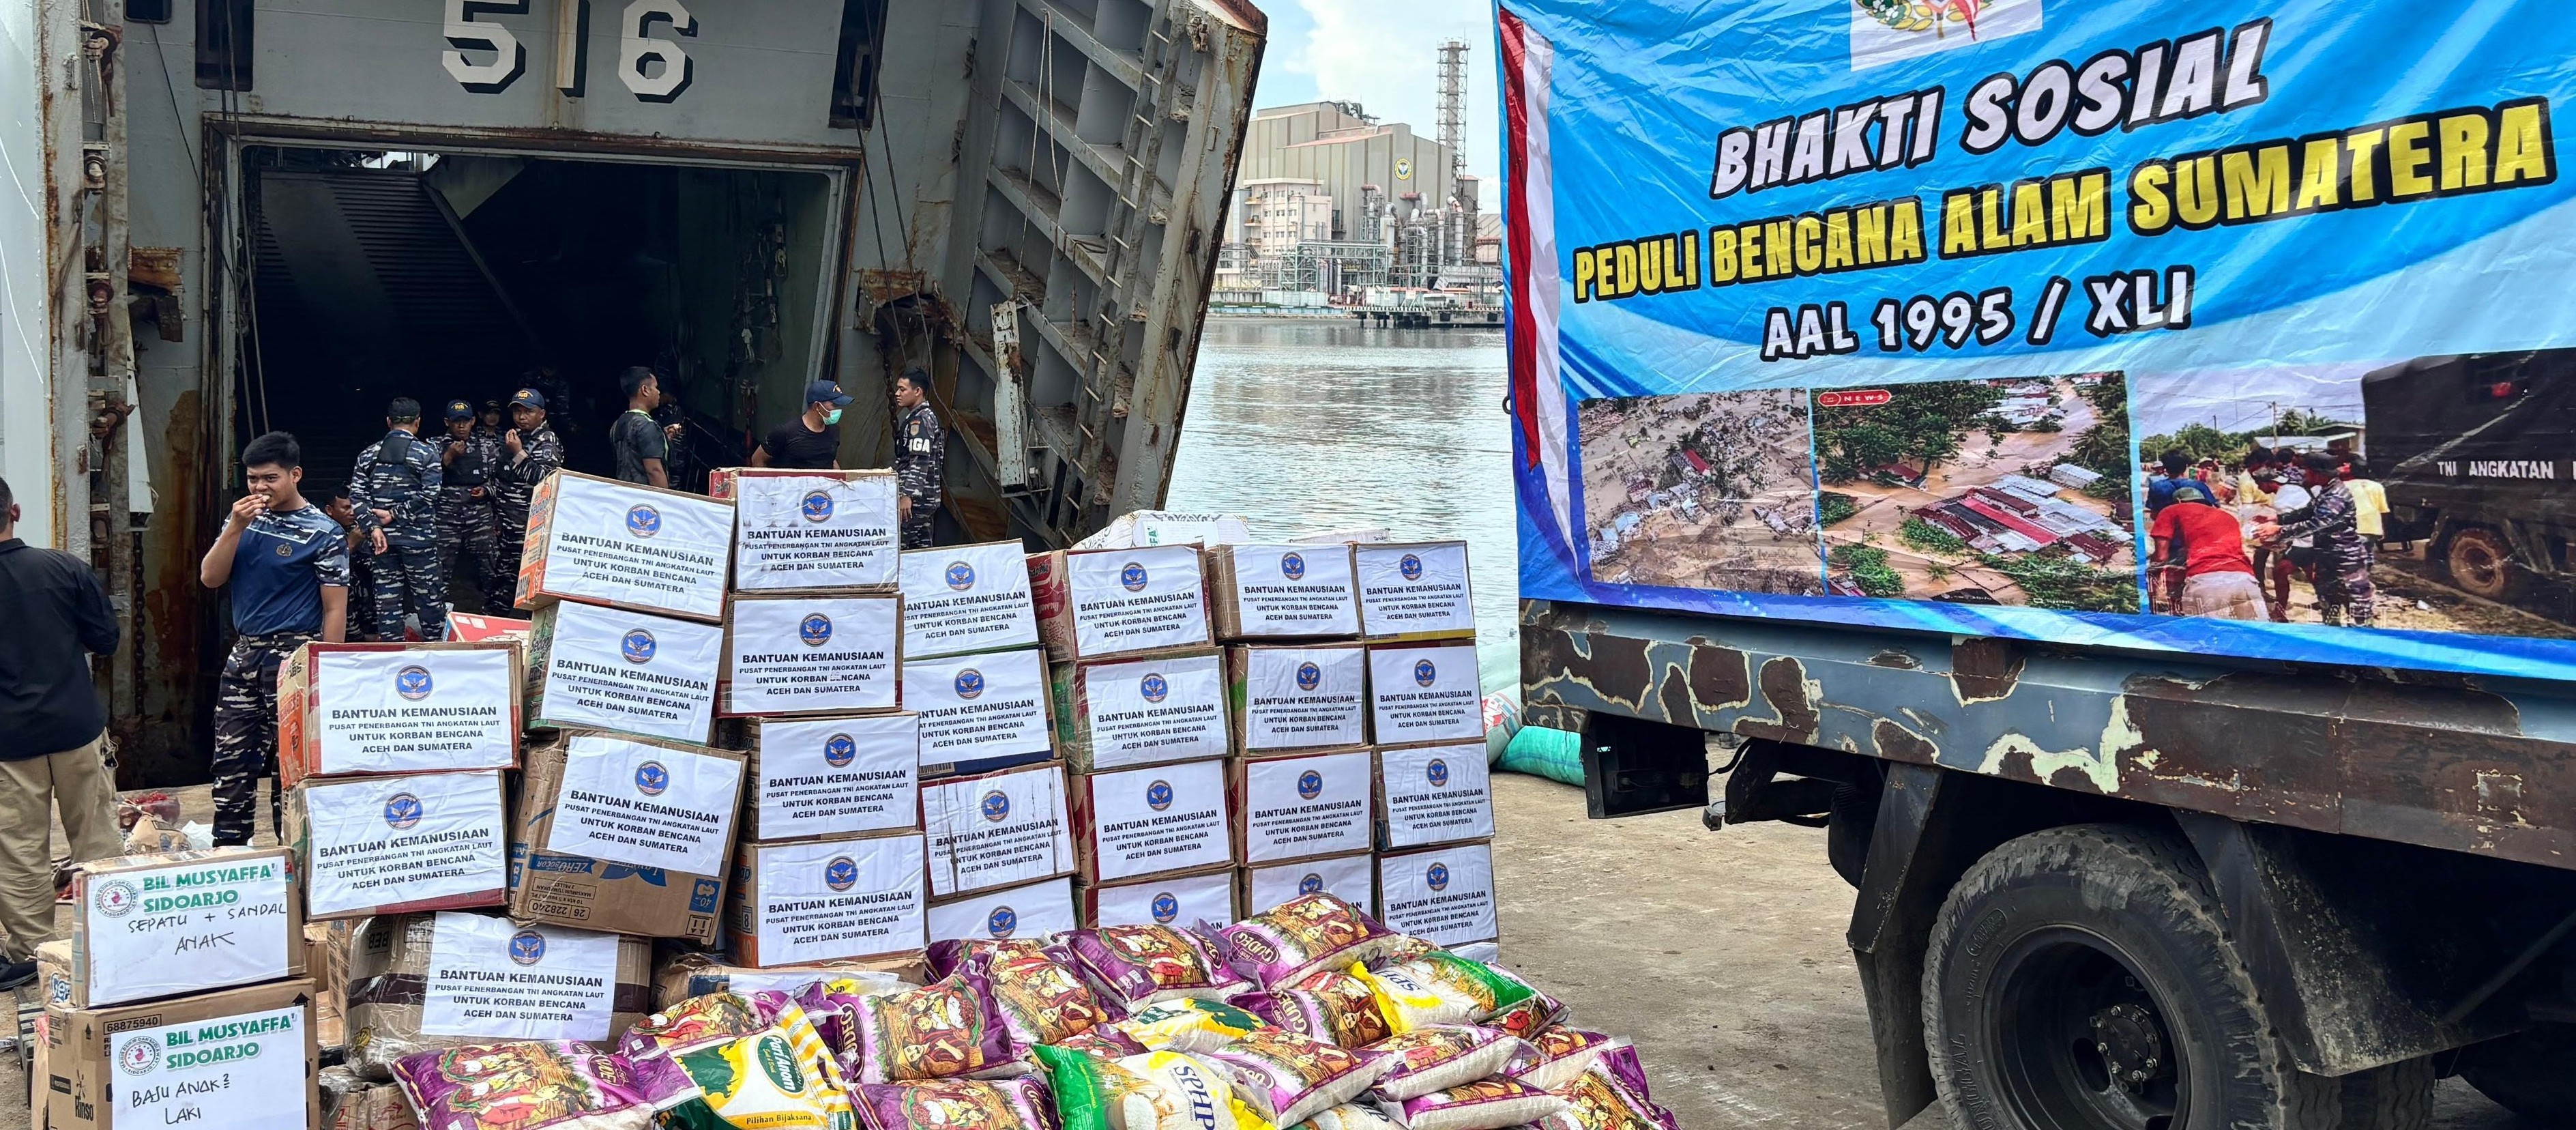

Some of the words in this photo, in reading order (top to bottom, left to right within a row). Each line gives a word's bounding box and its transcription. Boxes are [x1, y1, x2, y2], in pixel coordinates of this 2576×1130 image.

[1710, 85, 1946, 200] BHAKTI
[1960, 16, 2273, 155] SOSIAL
[1573, 230, 1701, 303] PEDULI
[1710, 195, 1927, 287] BENCANA
[1939, 166, 2111, 260] ALAM
[2128, 96, 2558, 237] SUMATERA
[1759, 300, 1860, 362] AAL
[1870, 287, 2016, 353] 1995
[2026, 277, 2070, 345] /
[2085, 264, 2195, 337] XLI
[1844, 394, 1884, 402] NEWS
[2469, 461, 2554, 479] ANGKATAN
[562, 533, 621, 549] BANTUAN
[626, 544, 713, 565] KEMANUSIAAN
[574, 558, 607, 569] UNTUK
[611, 564, 649, 576] KORBAN
[653, 571, 696, 584] BENCANA
[583, 572, 609, 581] ACEH
[612, 576, 631, 585] DAN
[634, 579, 684, 593] SUMATERA
[1406, 584, 1461, 592] KEMANUSIAAN
[1081, 600, 1125, 611] BANTUAN
[1128, 592, 1194, 606] KEMANUSIAAN
[1094, 620, 1119, 628] UNTUK
[1122, 617, 1152, 625] KORBAN
[1154, 613, 1186, 622] BENCANA
[1143, 624, 1180, 633] SUMATERA
[332, 709, 396, 719] BANTUAN
[402, 707, 496, 716] KEMANUSIAAN
[565, 804, 589, 812] PUSAT
[592, 809, 646, 822] PENERBANGAN
[662, 821, 700, 830] ANGKATAN
[571, 791, 630, 808] BANTUAN
[634, 802, 718, 823] KEMANUSIAAN
[581, 817, 615, 828] UNTUK
[617, 824, 656, 835] KORBAN
[658, 830, 700, 843] BENCANA
[589, 832, 615, 841] ACEH
[618, 836, 636, 845] DAN
[639, 840, 688, 853] SUMATERA
[558, 860, 589, 873] ZERO
[143, 889, 239, 913] SIDOARJO
[769, 900, 825, 913] BANTUAN
[830, 891, 911, 907] KEMANUSIAAN
[1391, 899, 1428, 911] BANTUAN
[1431, 890, 1486, 904] KEMANUSIAAN
[128, 915, 188, 933] SEPATU
[204, 912, 216, 923] +
[229, 903, 287, 920] SANDAL
[574, 908, 585, 918] 26
[791, 912, 843, 921] PENERBANGAN
[859, 906, 895, 914] ANGKATAN
[1401, 919, 1422, 927] UNTUK
[1424, 915, 1448, 924] KORBAN
[1450, 911, 1478, 920] BENCANA
[783, 925, 815, 933] UNTUK
[818, 921, 855, 930] KORBAN
[858, 916, 899, 925] BENCANA
[1441, 921, 1473, 931] SUMATERA
[174, 931, 236, 956] ANAK
[794, 936, 818, 944] ACEH
[843, 928, 889, 939] SUMATERA
[1235, 931, 1274, 963] GUDEG
[441, 970, 505, 981] BANTUAN
[510, 974, 602, 986] KEMANUSIAAN
[454, 996, 490, 1004] UNTUK
[494, 998, 535, 1006] KORBAN
[539, 1000, 585, 1009] BENCANA
[106, 1017, 159, 1032] 68875940
[464, 1009, 492, 1017] ACEH
[520, 1013, 572, 1021] SUMATERA
[166, 1042, 260, 1070] SIDOARJO
[1950, 1033, 1996, 1130] UNGGAL
[1173, 1064, 1216, 1130] SPHP
[75, 1095, 95, 1122] Rinso
[164, 1107, 202, 1125] LAKI
[746, 1114, 774, 1125] Pilihan
[776, 1112, 813, 1124] Bijaksana
